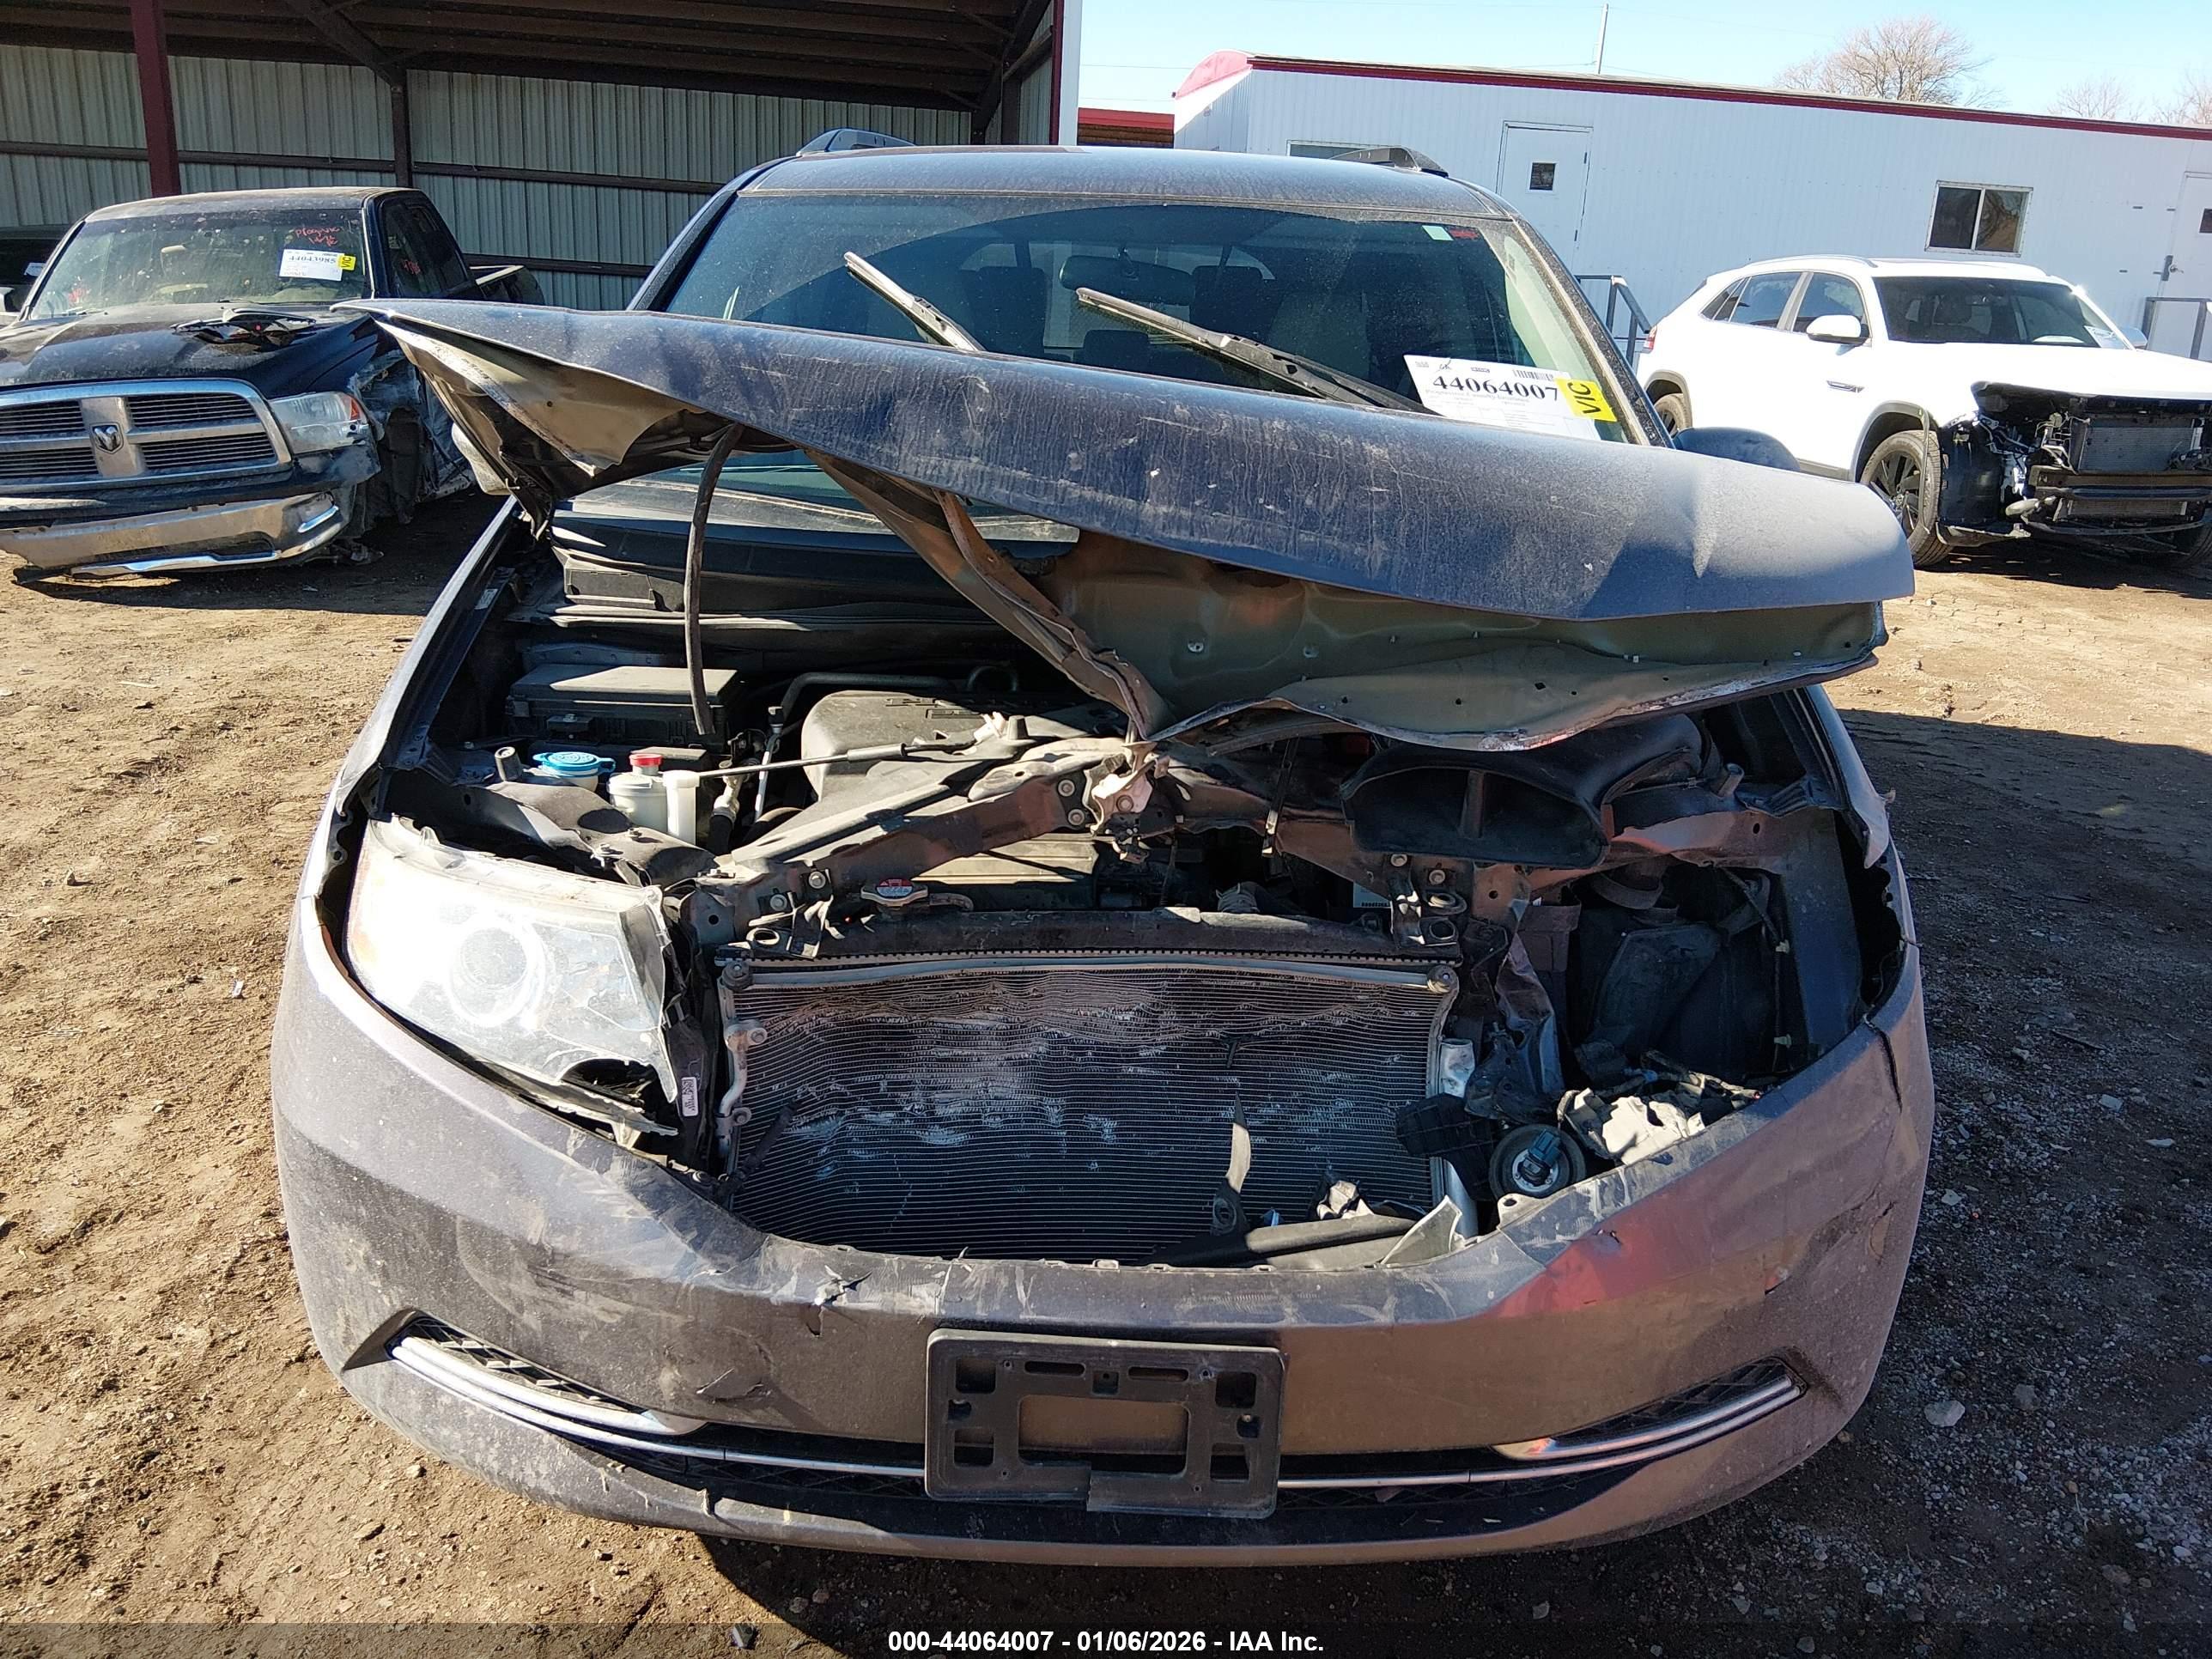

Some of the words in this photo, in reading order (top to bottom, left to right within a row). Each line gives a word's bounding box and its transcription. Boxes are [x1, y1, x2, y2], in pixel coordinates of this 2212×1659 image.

[341, 256, 352, 268] VIC
[1432, 375, 1558, 401] 44064007
[1567, 382, 1601, 414] VIC
